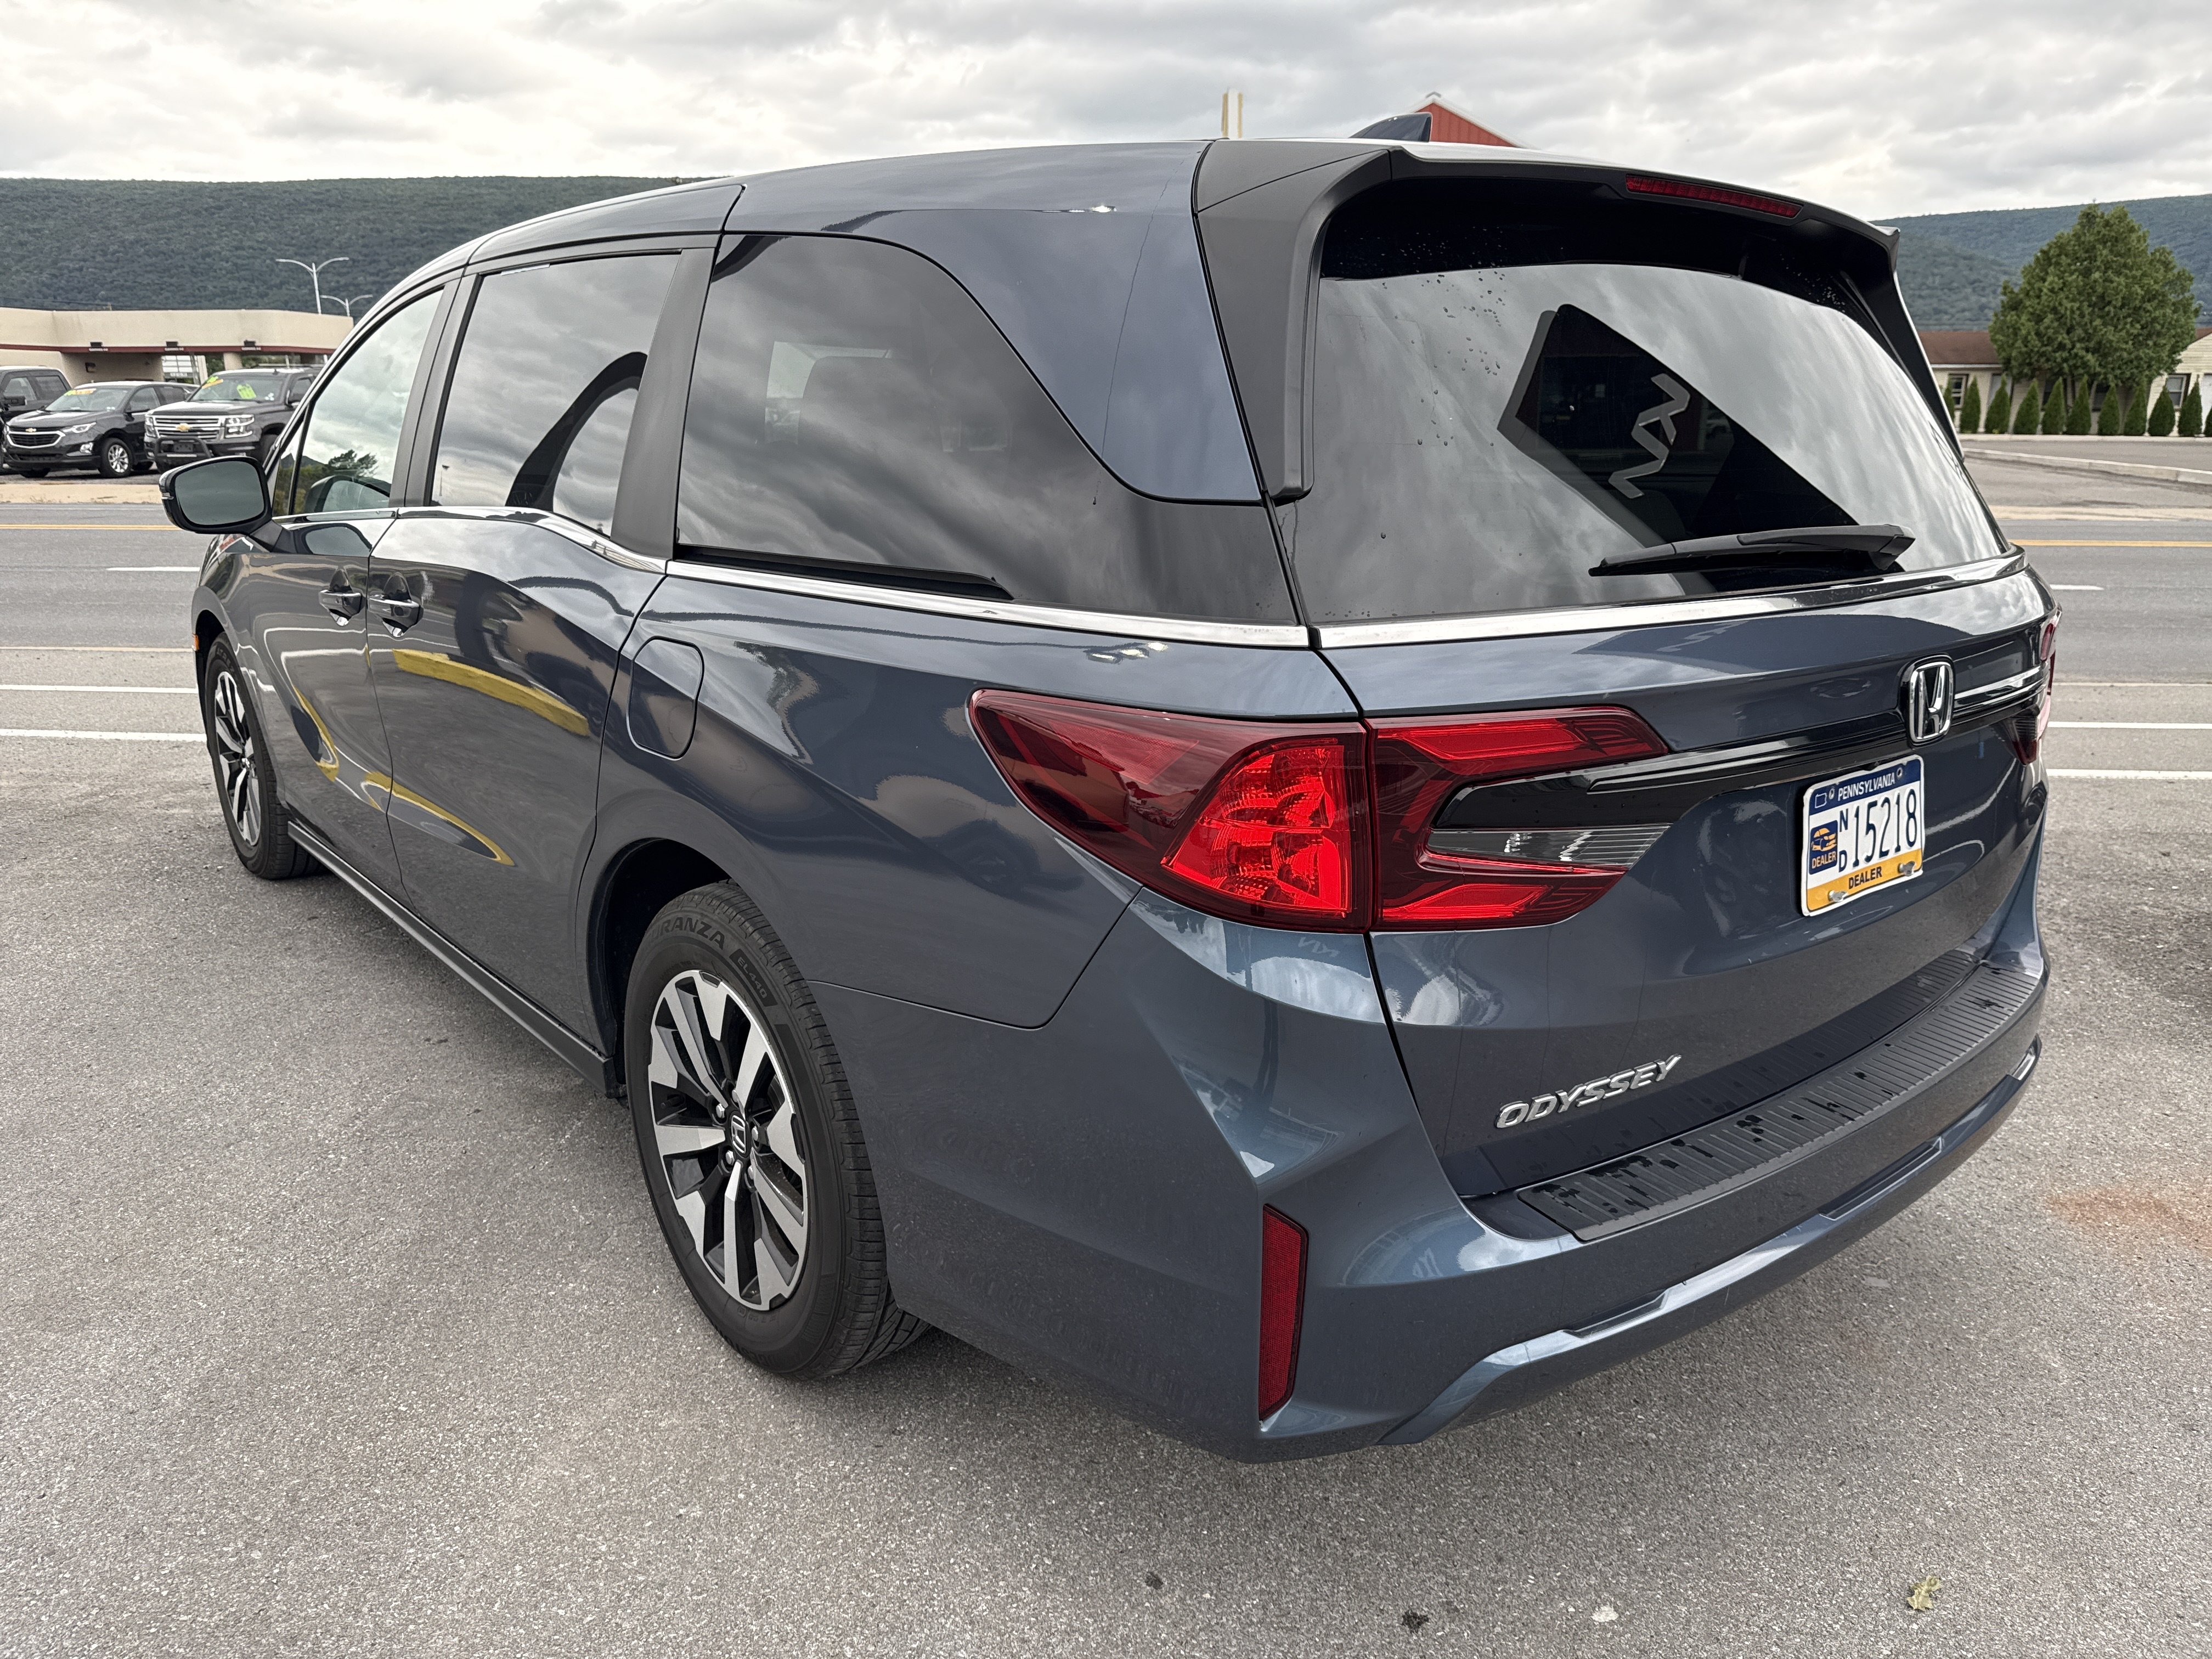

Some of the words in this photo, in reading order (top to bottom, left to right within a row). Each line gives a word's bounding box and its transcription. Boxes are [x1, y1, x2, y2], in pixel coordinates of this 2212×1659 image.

[1838, 773, 1895, 801] PENNSYLVANIA
[1852, 788, 1917, 867] 15218
[1812, 851, 1837, 869] DEALER
[1848, 866, 1882, 889] DEALER
[645, 917, 725, 950] URANZA
[737, 957, 768, 998] EL440
[1494, 1053, 1682, 1128] ODYSSEY
